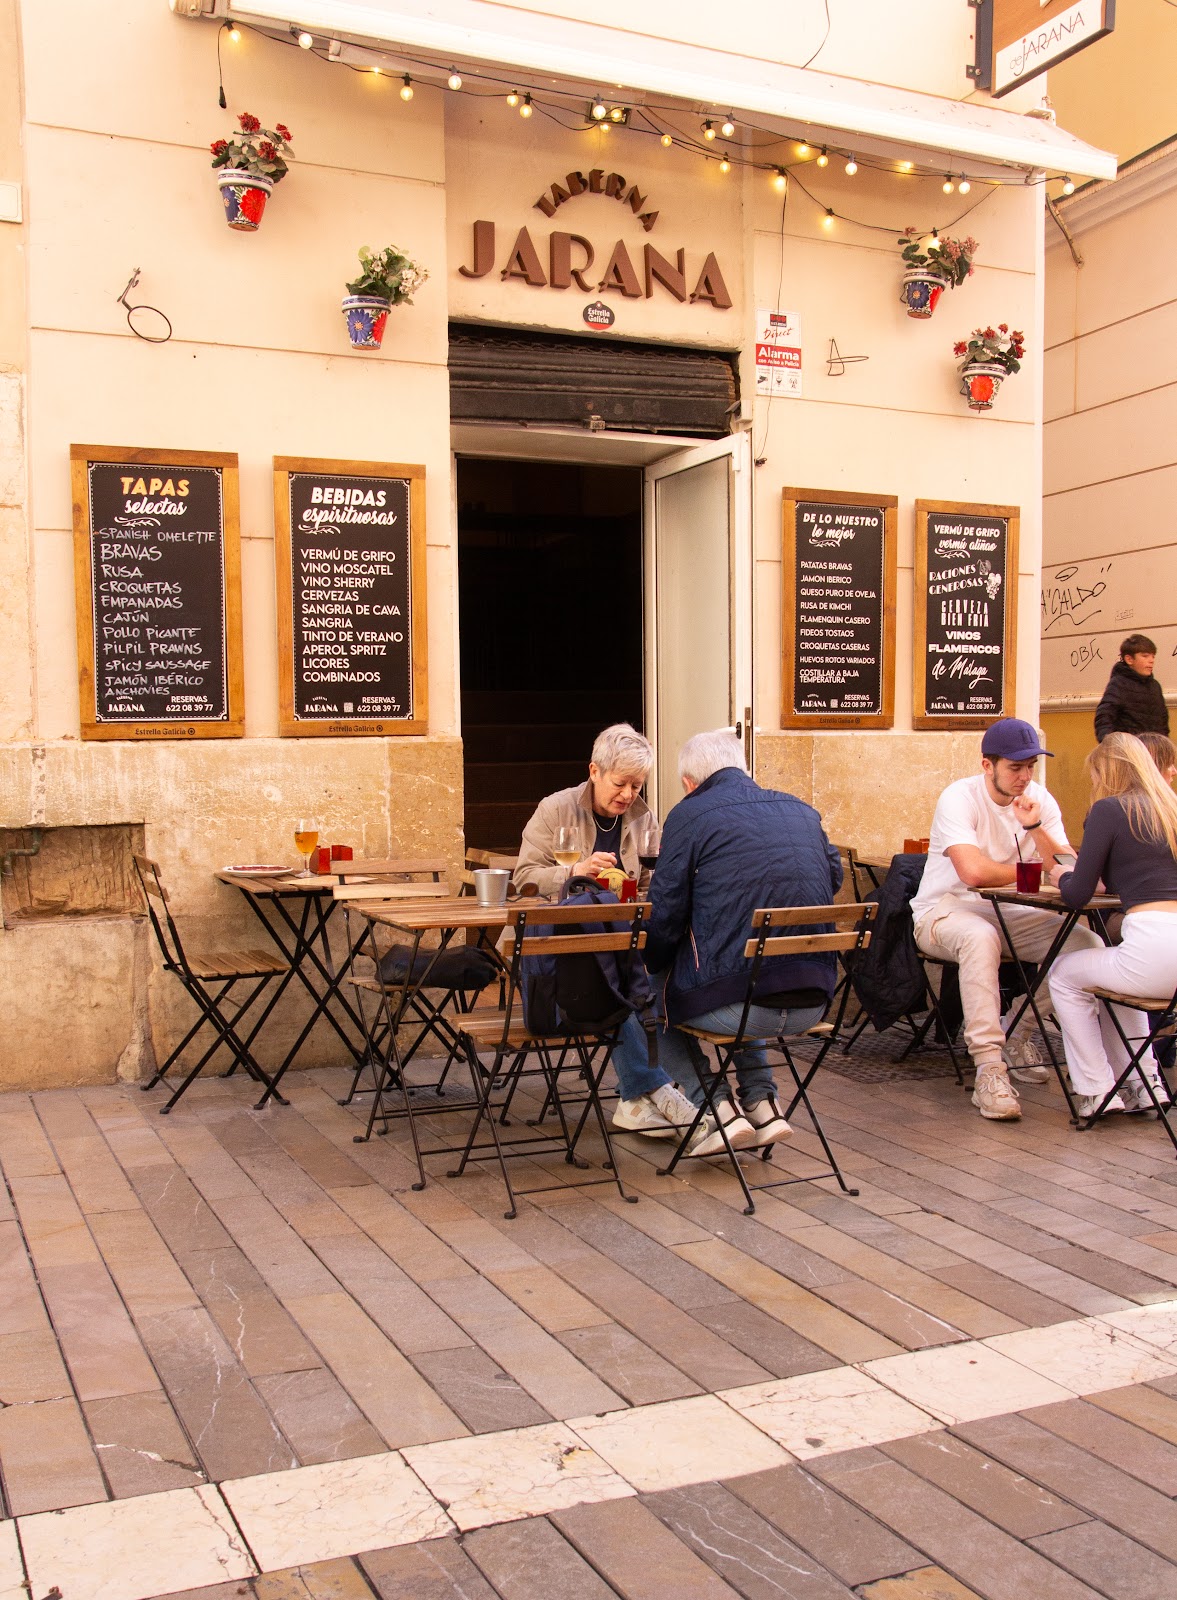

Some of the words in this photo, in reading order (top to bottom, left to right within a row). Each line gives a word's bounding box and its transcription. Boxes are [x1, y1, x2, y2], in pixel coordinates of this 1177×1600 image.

[533, 168, 660, 232] TABERNA
[458, 219, 733, 310] JARANA
[587, 307, 611, 317] Estrella
[588, 314, 609, 324] Galicia
[758, 346, 799, 361] Alarma
[120, 477, 190, 496] TAPAS
[311, 487, 387, 506] BEBIDAS
[124, 497, 187, 515] selectas
[302, 505, 397, 530] espirituosas
[803, 513, 816, 523] DE
[819, 514, 832, 524] LO
[835, 515, 878, 527] NUESTRO
[157, 531, 217, 544] OMELETTE
[811, 524, 824, 538] lo
[826, 526, 855, 542] mejor
[934, 524, 962, 536] VERMÚ
[964, 527, 974, 536] DE
[975, 527, 1000, 538] GRIFO
[100, 544, 162, 562] BRAVAS
[300, 547, 341, 560] VERMÚ
[344, 550, 359, 560] DE
[361, 551, 396, 562] GRIFO
[100, 564, 144, 579] RUSA
[301, 562, 331, 574] VINO
[334, 564, 393, 575] MOSCATEL
[800, 561, 827, 570] PATATAS
[829, 563, 853, 571] BRAVAS
[929, 564, 976, 581] RACIONES
[99, 581, 182, 594] CROQUETAS
[301, 576, 331, 587] VINO
[334, 577, 375, 588] SHERRY
[928, 577, 983, 595] GENEROSAS
[301, 590, 359, 602] CERVEZAS
[800, 588, 824, 596] QUESO
[826, 589, 844, 597] PURO
[855, 591, 876, 599] OVEJA
[101, 595, 183, 609] EMPANADAS
[819, 602, 828, 610] DE
[829, 603, 851, 611] KIMCHI
[941, 599, 988, 614] CERVEZA
[302, 603, 353, 615] SANGRIA
[355, 604, 370, 615] DE
[373, 605, 401, 616] CAVA
[302, 617, 353, 628] SANGRIA
[800, 615, 844, 624] FLAMENQUIN
[844, 616, 871, 624] CASERO
[102, 627, 140, 638] POLLO
[302, 630, 337, 642] TINTO
[339, 631, 353, 642] DE
[356, 631, 404, 643] VERANO
[800, 629, 824, 637] FIDEOS
[825, 629, 854, 637] TOSTAOS
[945, 631, 981, 641] VINOS
[150, 642, 203, 656] PRAWNS
[302, 644, 348, 655] APEROL
[350, 645, 387, 656] SPRITZ
[800, 642, 840, 650] CROQUETAS
[841, 643, 870, 651] CASERAS
[928, 644, 1000, 655] FLAMENCOS
[145, 659, 212, 670] SAUSSAGE
[302, 658, 350, 669] LICORES
[800, 656, 824, 664] HUEVOS
[825, 656, 845, 664] ROTOS
[800, 669, 836, 677] COSTILLAR
[931, 658, 947, 680] de
[104, 674, 148, 687] JAMÓN
[303, 671, 381, 683] COMBINADOS
[107, 704, 145, 712] JARANA
[166, 704, 181, 712] 622
[182, 704, 193, 712] 08
[193, 704, 203, 712] 39
[204, 704, 214, 712] 77
[304, 704, 338, 712] JARANA
